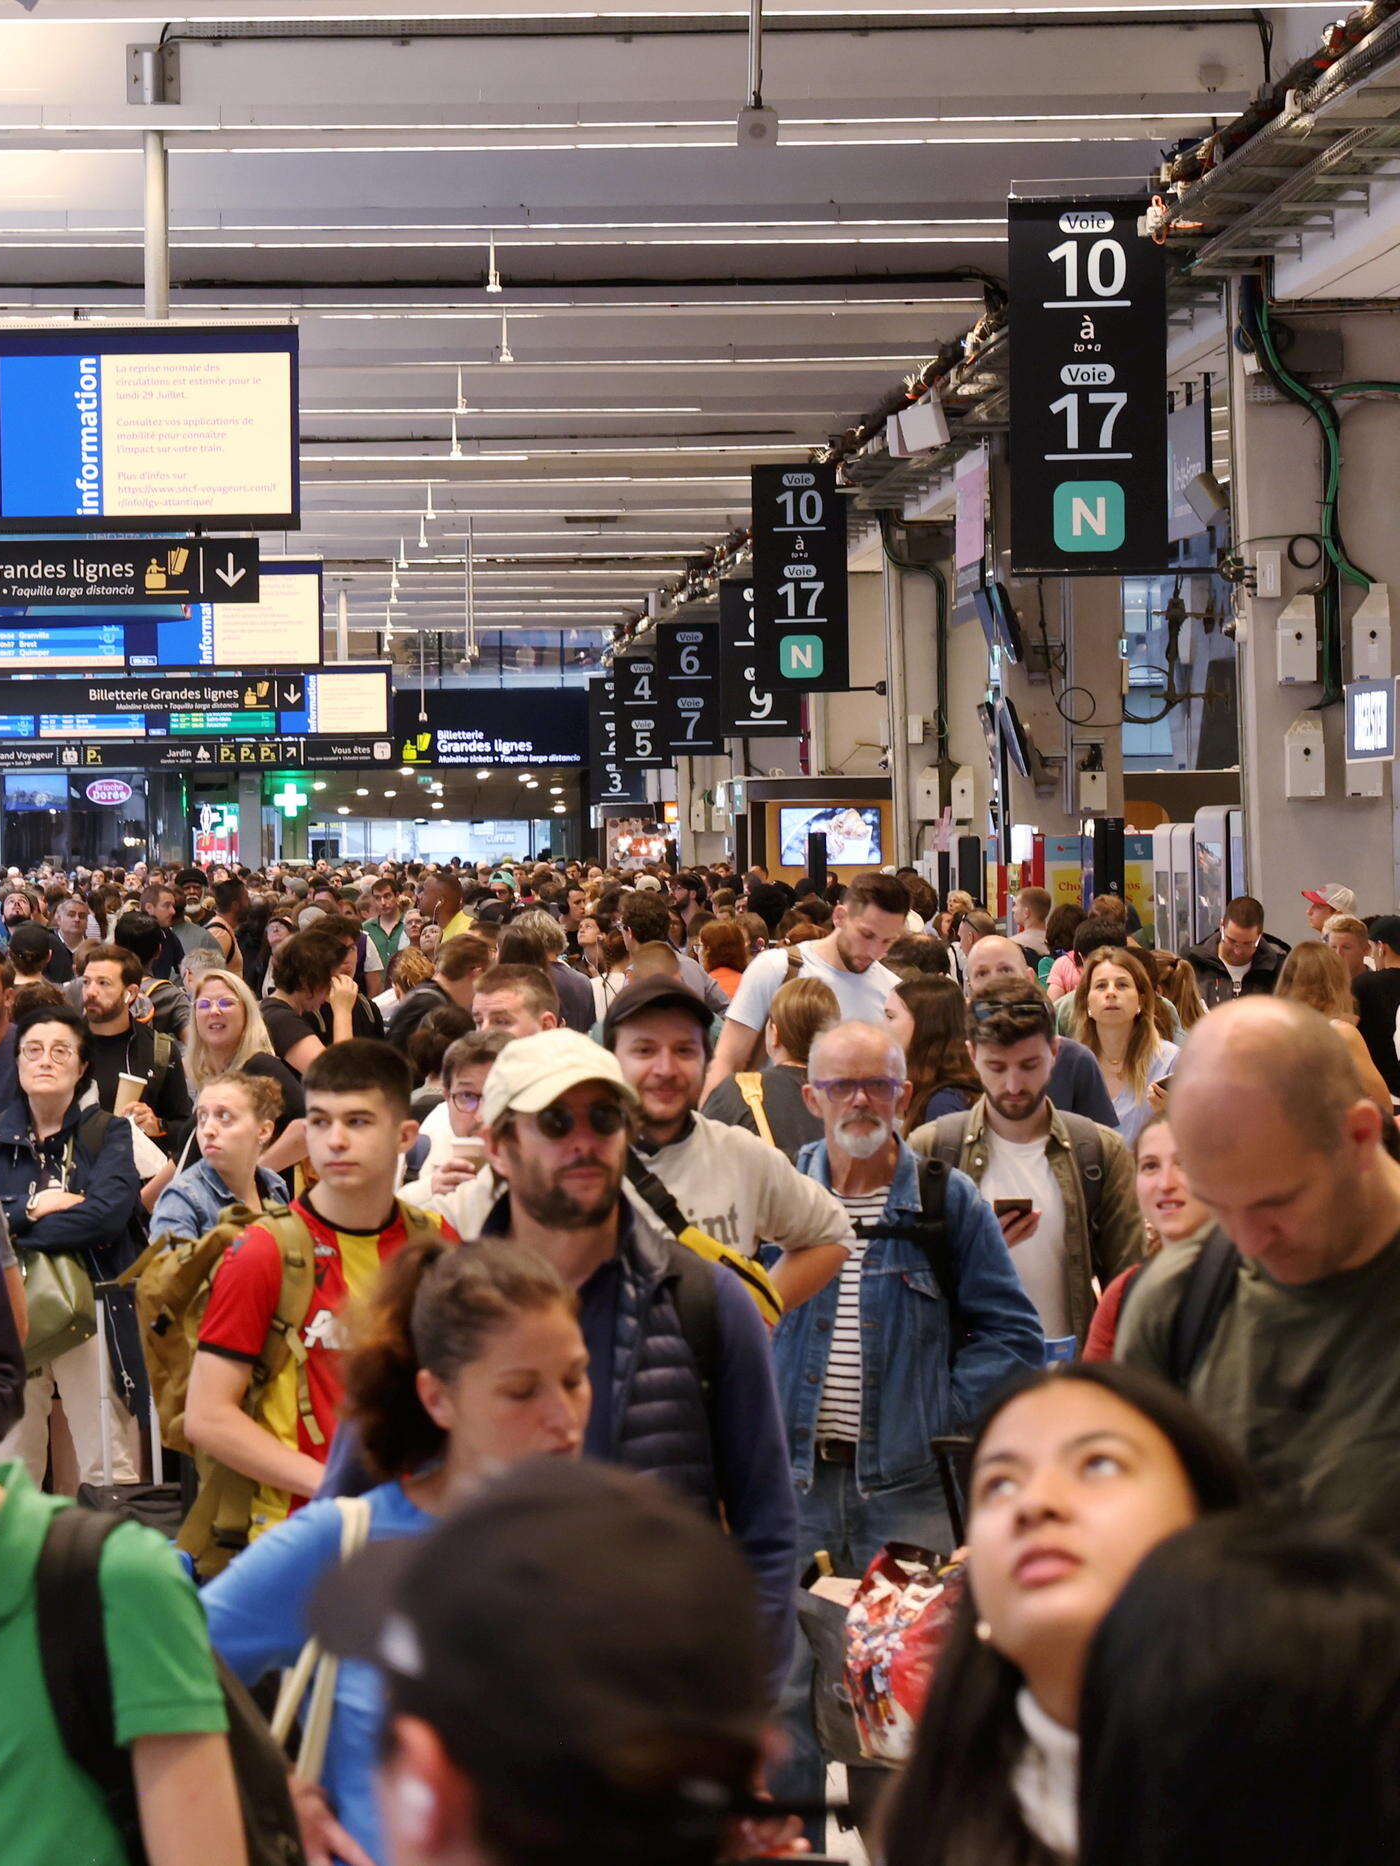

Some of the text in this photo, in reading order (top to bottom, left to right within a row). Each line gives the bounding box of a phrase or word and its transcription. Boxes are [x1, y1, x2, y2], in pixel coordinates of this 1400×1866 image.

[1066, 214, 1107, 231] Voie
[1046, 238, 1127, 298] 10
[1078, 315, 1095, 340] à
[1073, 342, 1085, 353] to
[1067, 367, 1108, 383] Voie
[1048, 392, 1128, 450] 17
[74, 358, 99, 516] information
[785, 474, 812, 486] Voie
[775, 489, 823, 526] 10
[1072, 496, 1106, 537] N
[794, 534, 805, 551] à
[72, 558, 135, 584] lignes
[786, 566, 813, 577] Voie
[11, 586, 54, 600] Taquilla
[56, 585, 83, 600] larga
[86, 585, 136, 597] distancia
[776, 581, 825, 617] 17
[680, 632, 700, 643] Voie
[680, 646, 700, 674] 6
[790, 644, 814, 669] N
[88, 687, 149, 702] Billetterie
[150, 687, 202, 701] Grandes
[203, 686, 239, 702] lignes
[633, 675, 652, 700] 4
[681, 698, 701, 708] Voie
[437, 729, 484, 741] Billetterie
[680, 711, 702, 740] 7
[16, 751, 54, 762] Voyageur
[166, 748, 192, 759] Jardin
[331, 746, 352, 755] Vous
[353, 745, 371, 755] êtes
[437, 738, 533, 755] Grandes lignes
[635, 731, 653, 757] 5
[608, 772, 623, 793] 3
